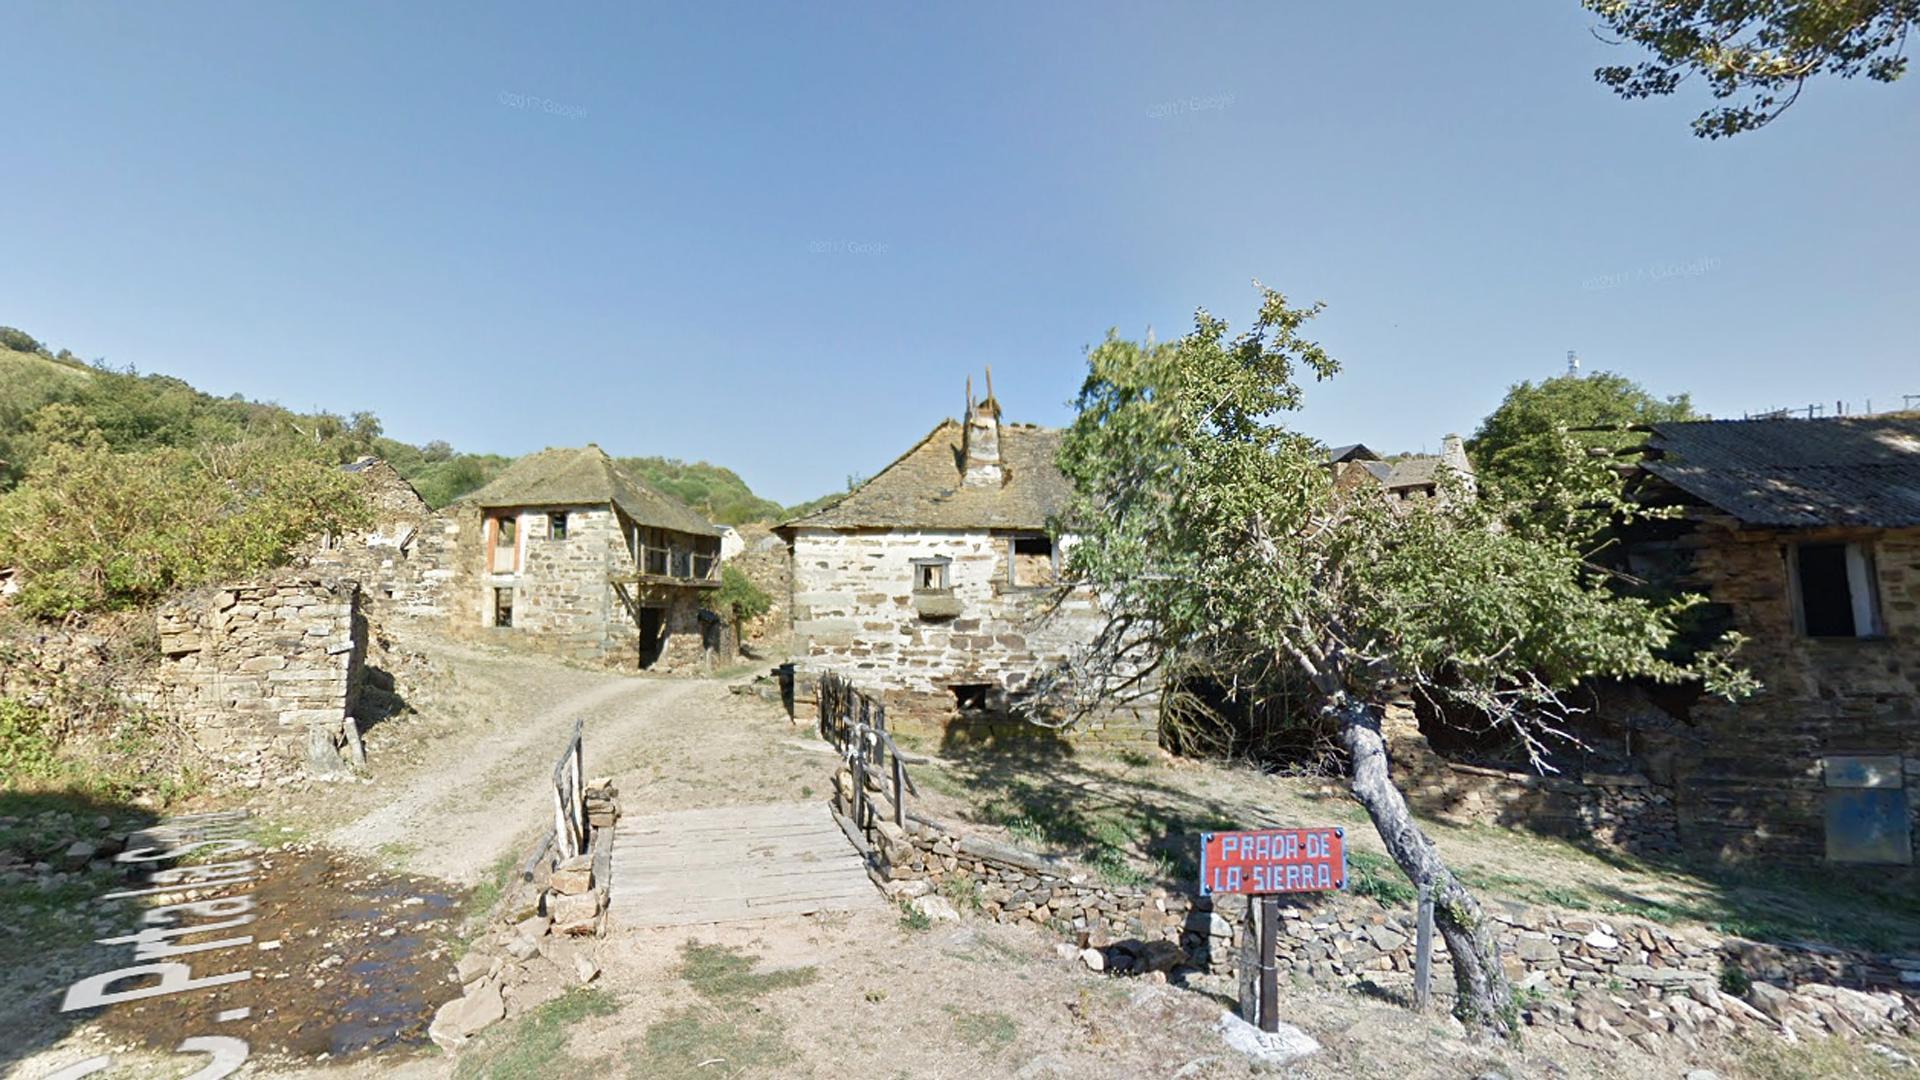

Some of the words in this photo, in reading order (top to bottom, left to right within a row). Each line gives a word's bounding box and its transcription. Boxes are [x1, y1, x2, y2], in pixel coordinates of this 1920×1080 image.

[1222, 833, 1298, 861] PRADA
[1306, 832, 1331, 859] DE
[1214, 865, 1242, 892] LA
